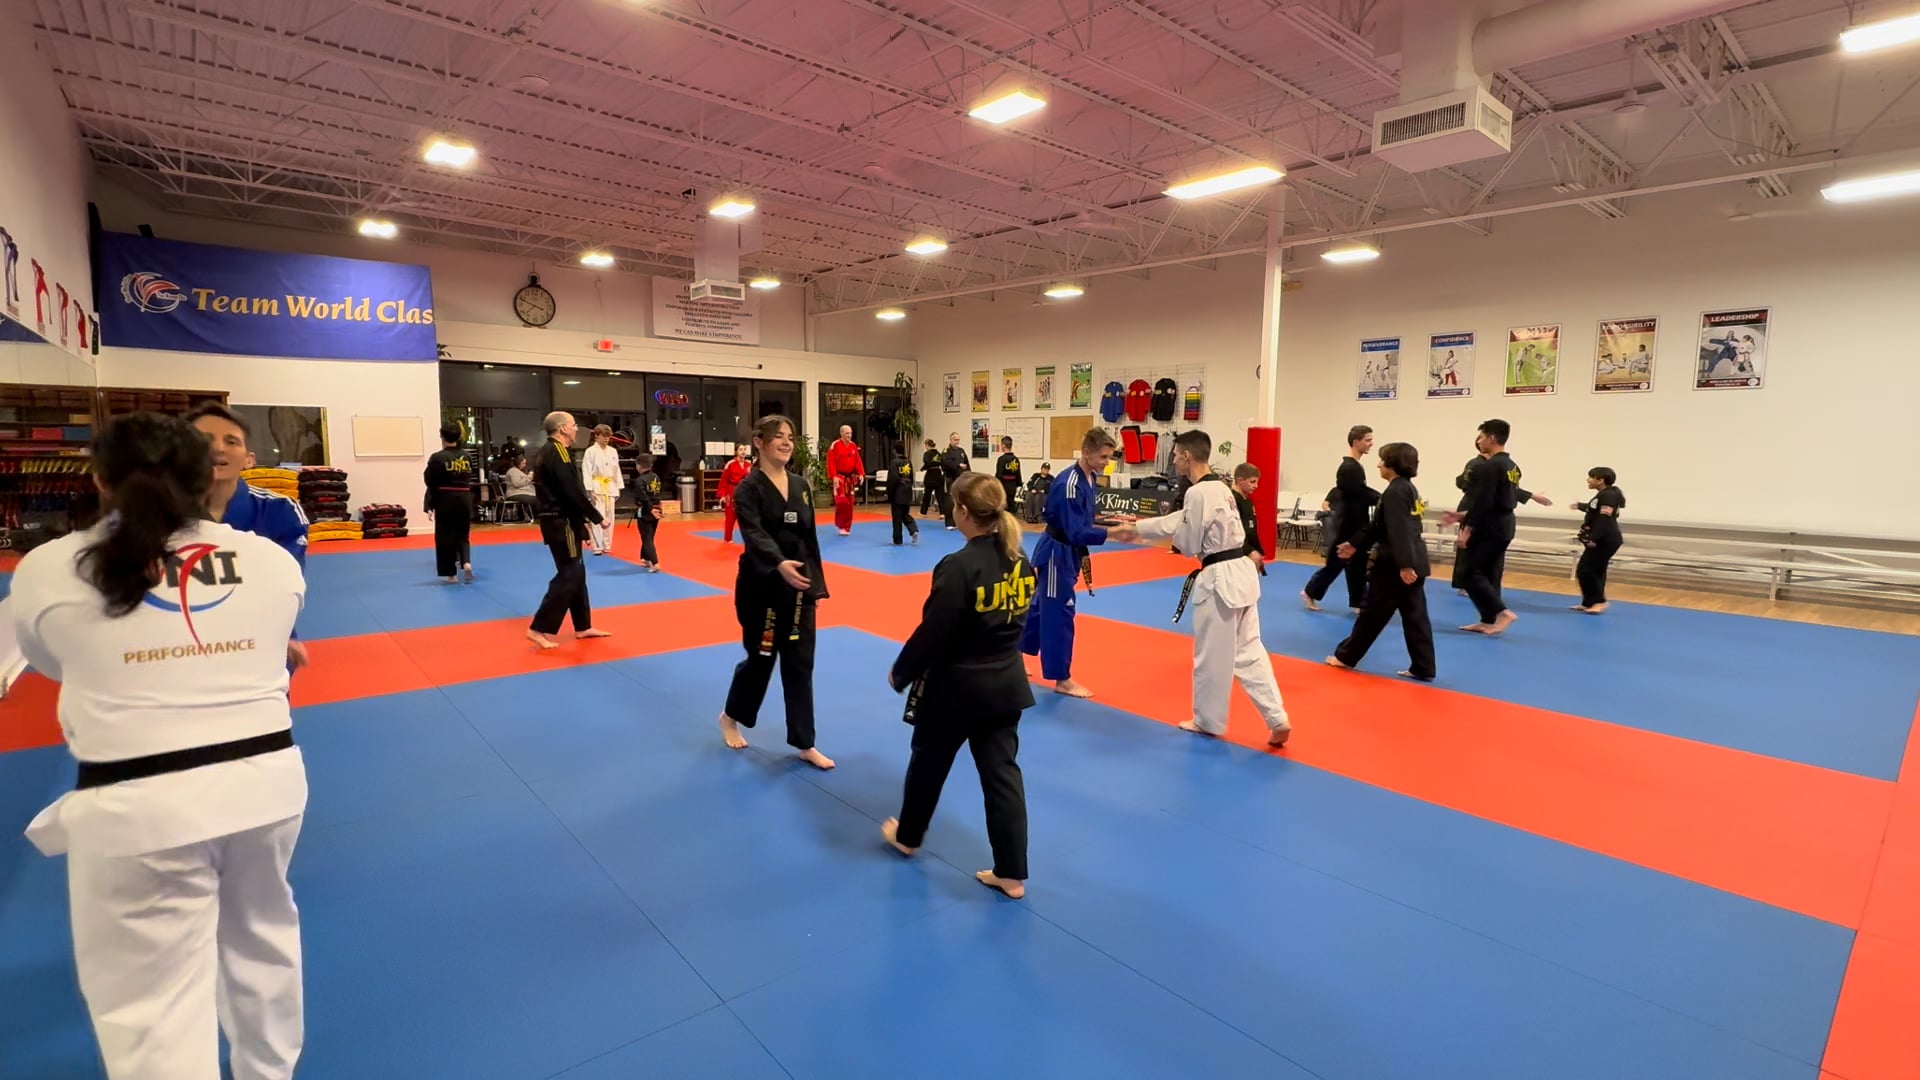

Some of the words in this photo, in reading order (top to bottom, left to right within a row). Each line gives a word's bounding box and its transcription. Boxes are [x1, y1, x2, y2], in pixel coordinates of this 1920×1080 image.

[192, 287, 280, 317] Team
[285, 294, 372, 322] World
[376, 300, 434, 325] Clas
[1602, 321, 1655, 330] ONSIBILITY
[1711, 313, 1759, 322] LEADERSHIP
[1435, 335, 1469, 343] CONFIDENCE
[1102, 493, 1140, 511] Kim's
[155, 550, 243, 588] NI
[124, 639, 256, 664] PERFORMANCE
